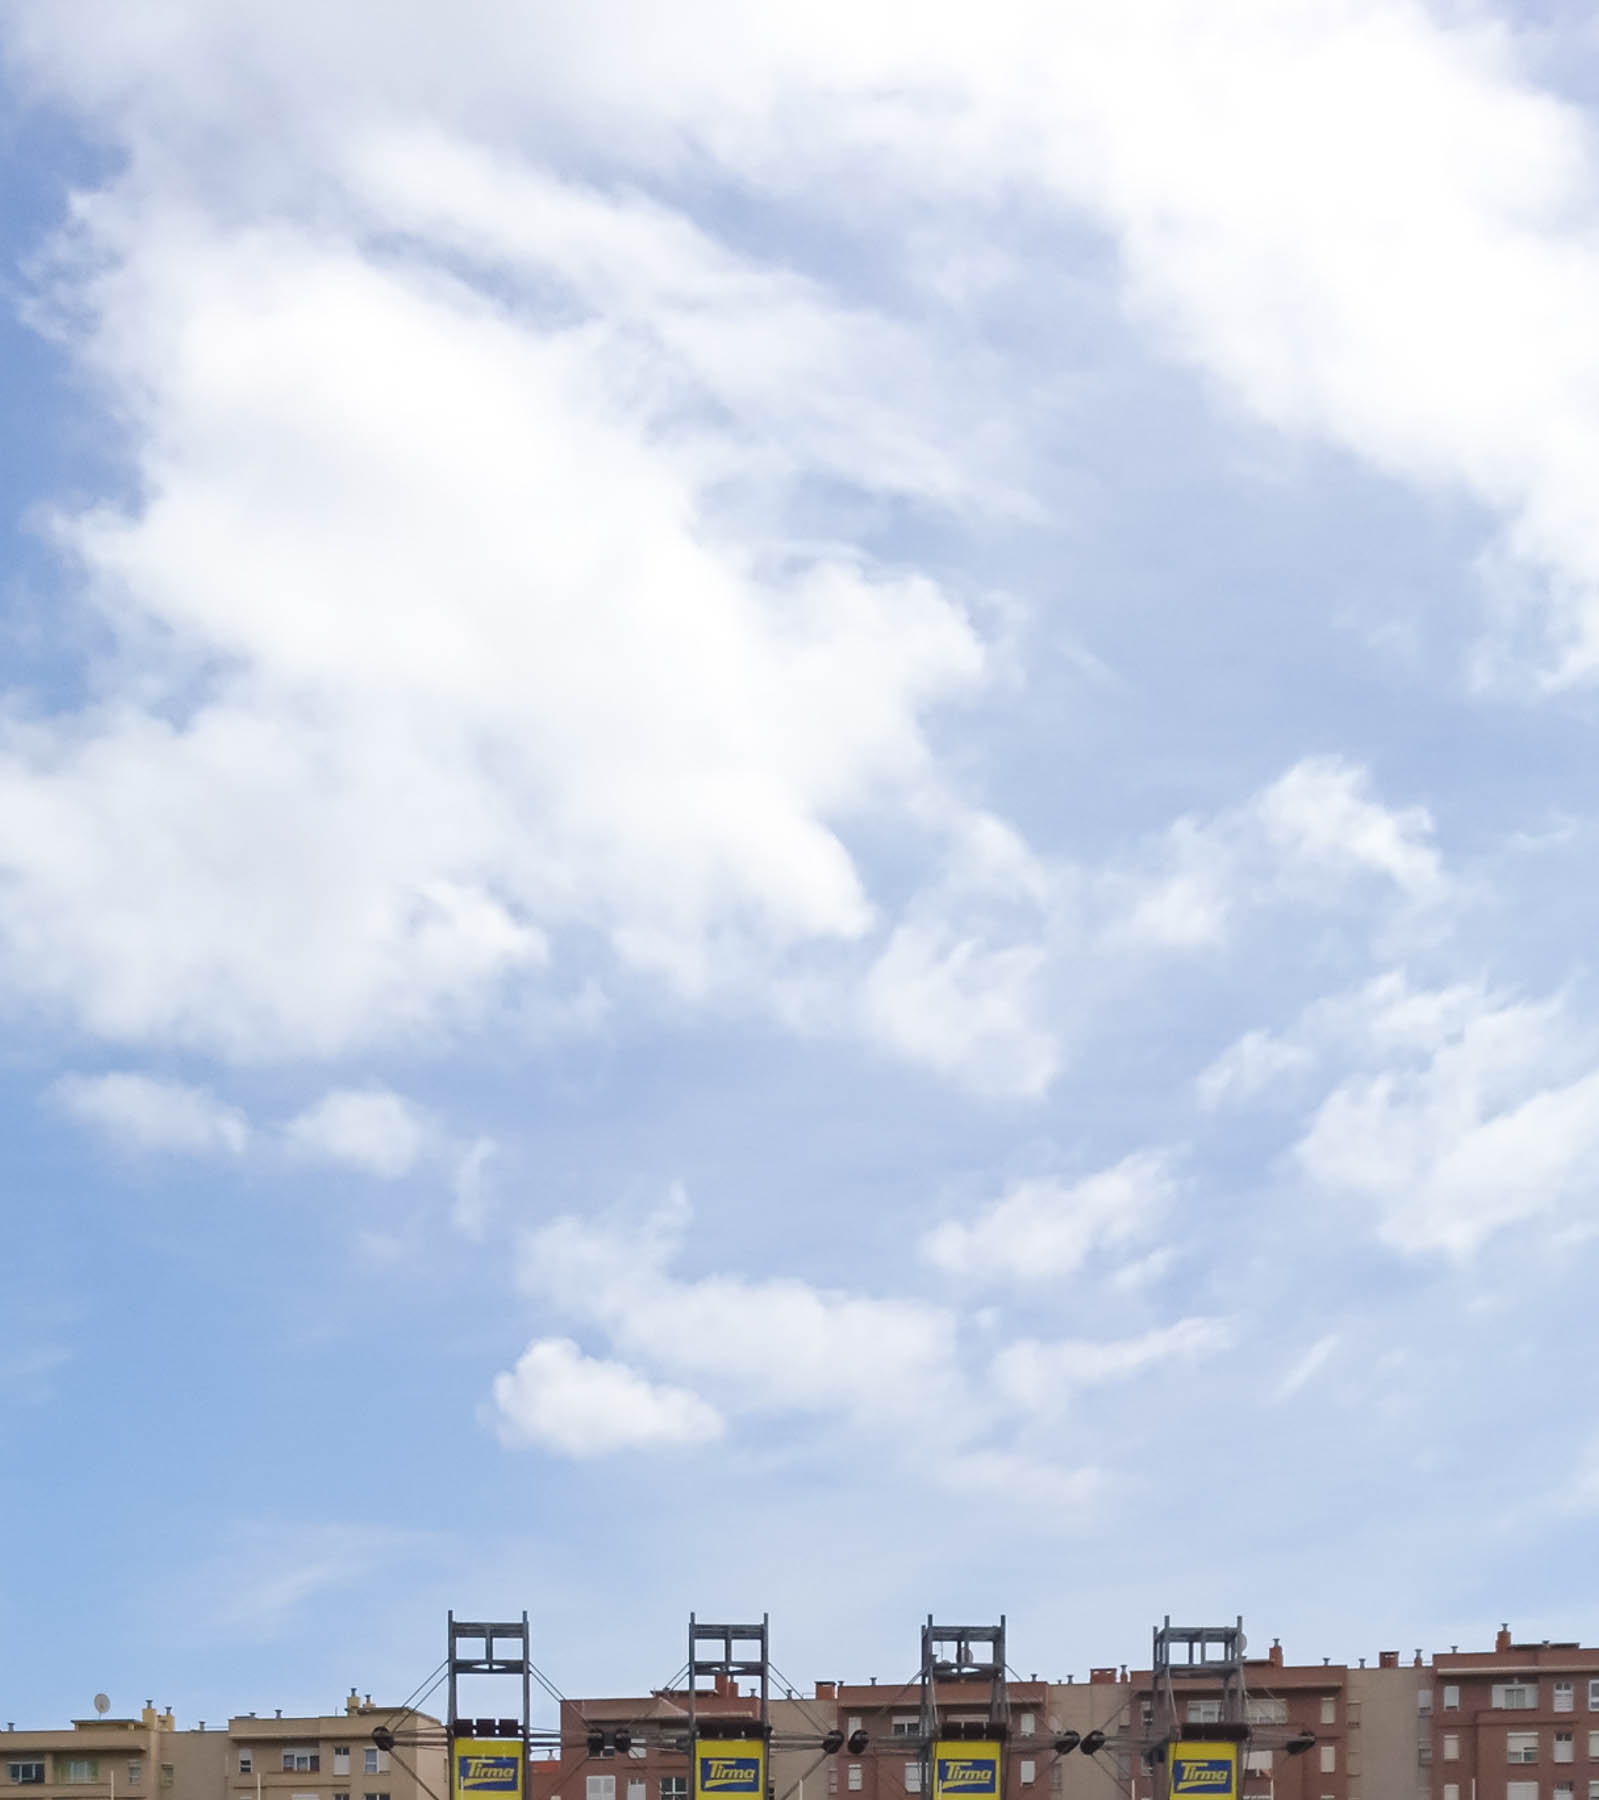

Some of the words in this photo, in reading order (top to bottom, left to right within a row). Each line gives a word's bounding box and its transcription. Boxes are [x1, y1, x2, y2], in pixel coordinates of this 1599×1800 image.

[466, 1759, 514, 1778] Tirma
[708, 1760, 755, 1778] Tirma
[945, 1762, 992, 1780] Tirma
[1180, 1762, 1228, 1780] Tirma
